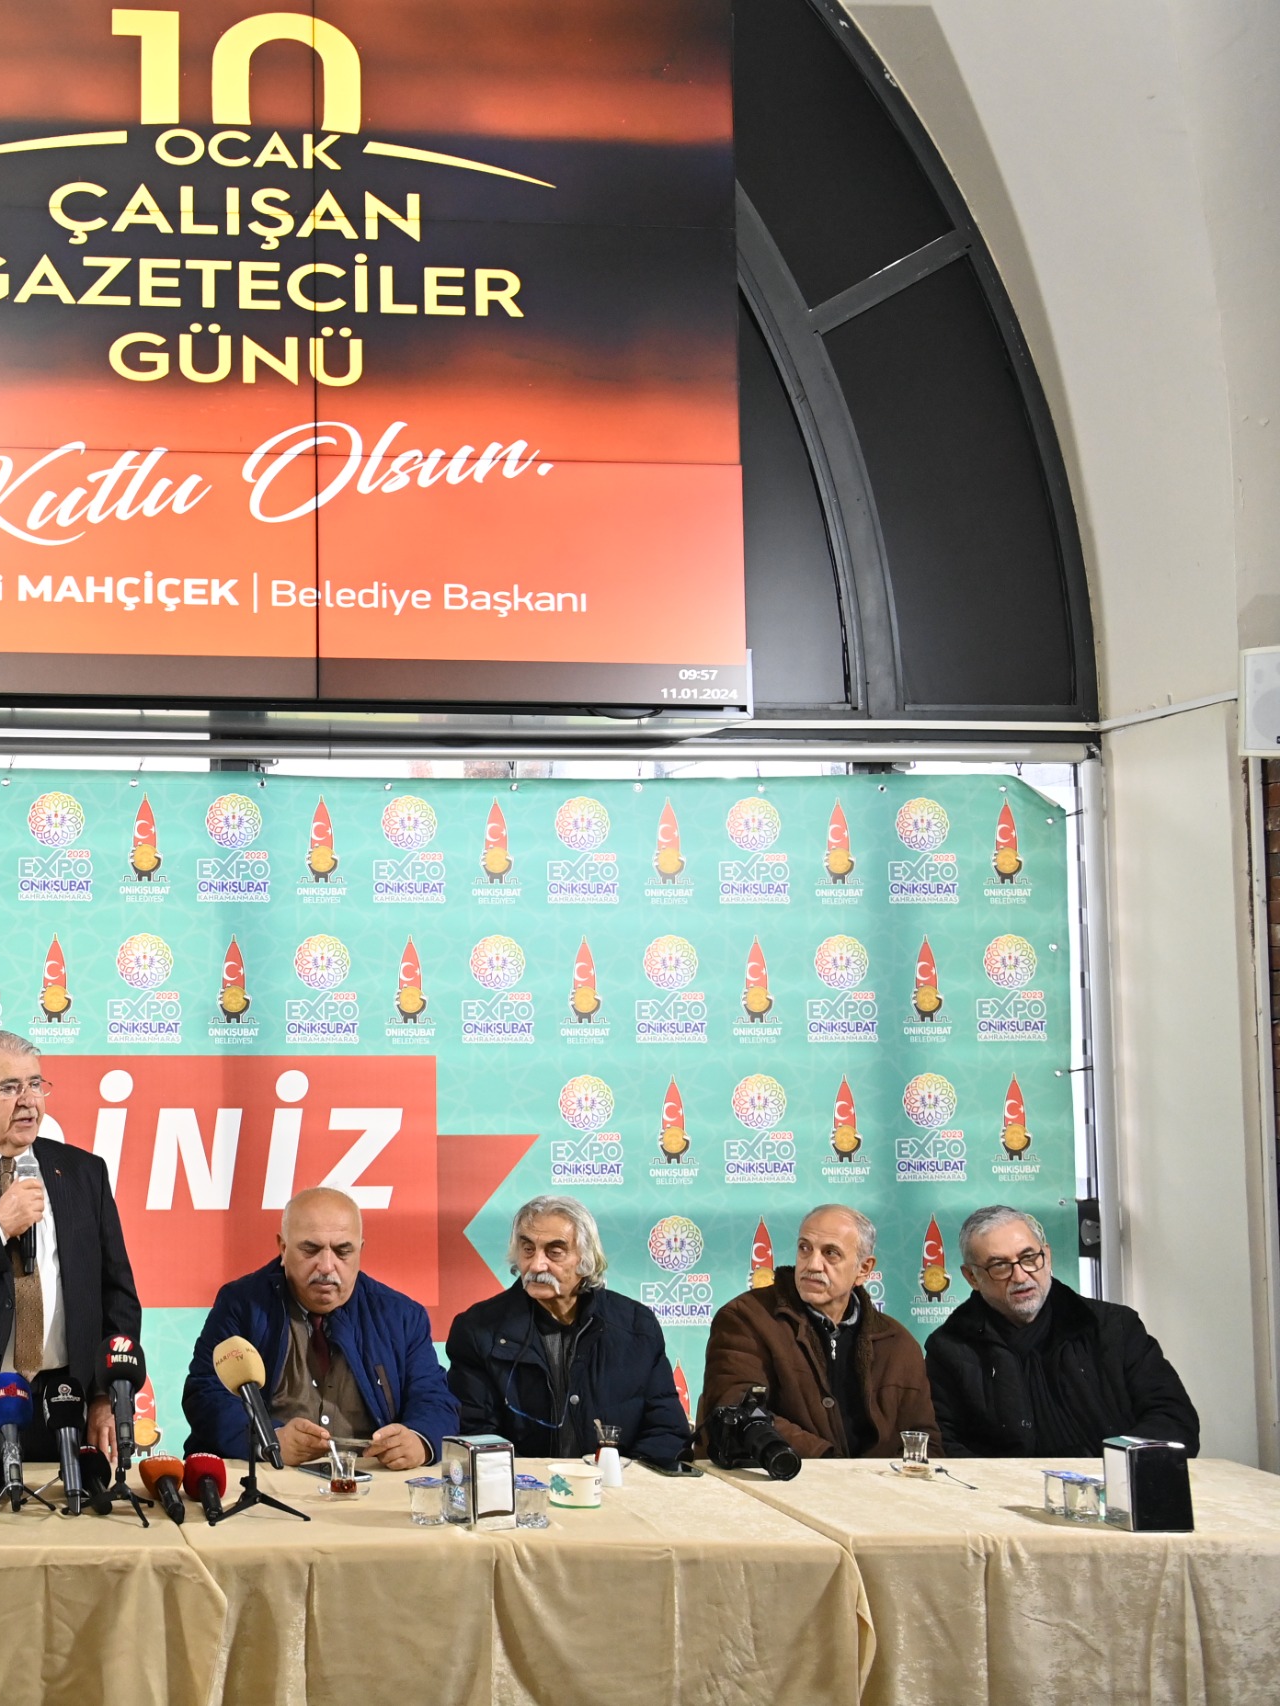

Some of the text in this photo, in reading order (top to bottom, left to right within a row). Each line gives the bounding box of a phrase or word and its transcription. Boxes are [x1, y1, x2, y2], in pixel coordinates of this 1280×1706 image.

[111, 9, 361, 134] 10
[155, 129, 342, 170] OCAK
[48, 182, 422, 250] ÇALIŞAN
[109, 323, 363, 387] GÜNÜ
[241, 421, 554, 524] Olsun.
[17, 570, 239, 613] MAHÇİÇEK
[272, 580, 432, 616] Belediye
[444, 583, 588, 619] Başkanı
[678, 669, 718, 681] 09:57
[661, 688, 738, 700] 11.01.2024
[22, 851, 91, 878] EXPO
[67, 851, 90, 859] 2023
[199, 851, 269, 879] EXPO
[245, 851, 268, 859] 2023
[376, 853, 444, 880] EXPO
[550, 854, 617, 881] EXPO
[720, 854, 787, 881] EXPO
[890, 854, 957, 881] EXPO
[110, 992, 180, 1020] EXPO
[156, 992, 179, 1000] 2023
[288, 992, 357, 1020] EXPO
[333, 993, 356, 1001] 2023
[464, 992, 533, 1020] EXPO
[637, 992, 705, 1019] EXPO
[809, 992, 877, 1019] EXPO
[854, 992, 876, 1000] 2023
[979, 991, 1046, 1018] EXPO
[554, 1133, 622, 1160] EXPO
[599, 1134, 621, 1142] 2023
[726, 1132, 795, 1159] EXPO
[771, 1132, 794, 1140] 2023
[898, 1132, 965, 1158] EXPO
[942, 1132, 964, 1140] 2023
[642, 1274, 711, 1302] EXPO
[650, 1305, 711, 1317] NİKİŞUBAT
